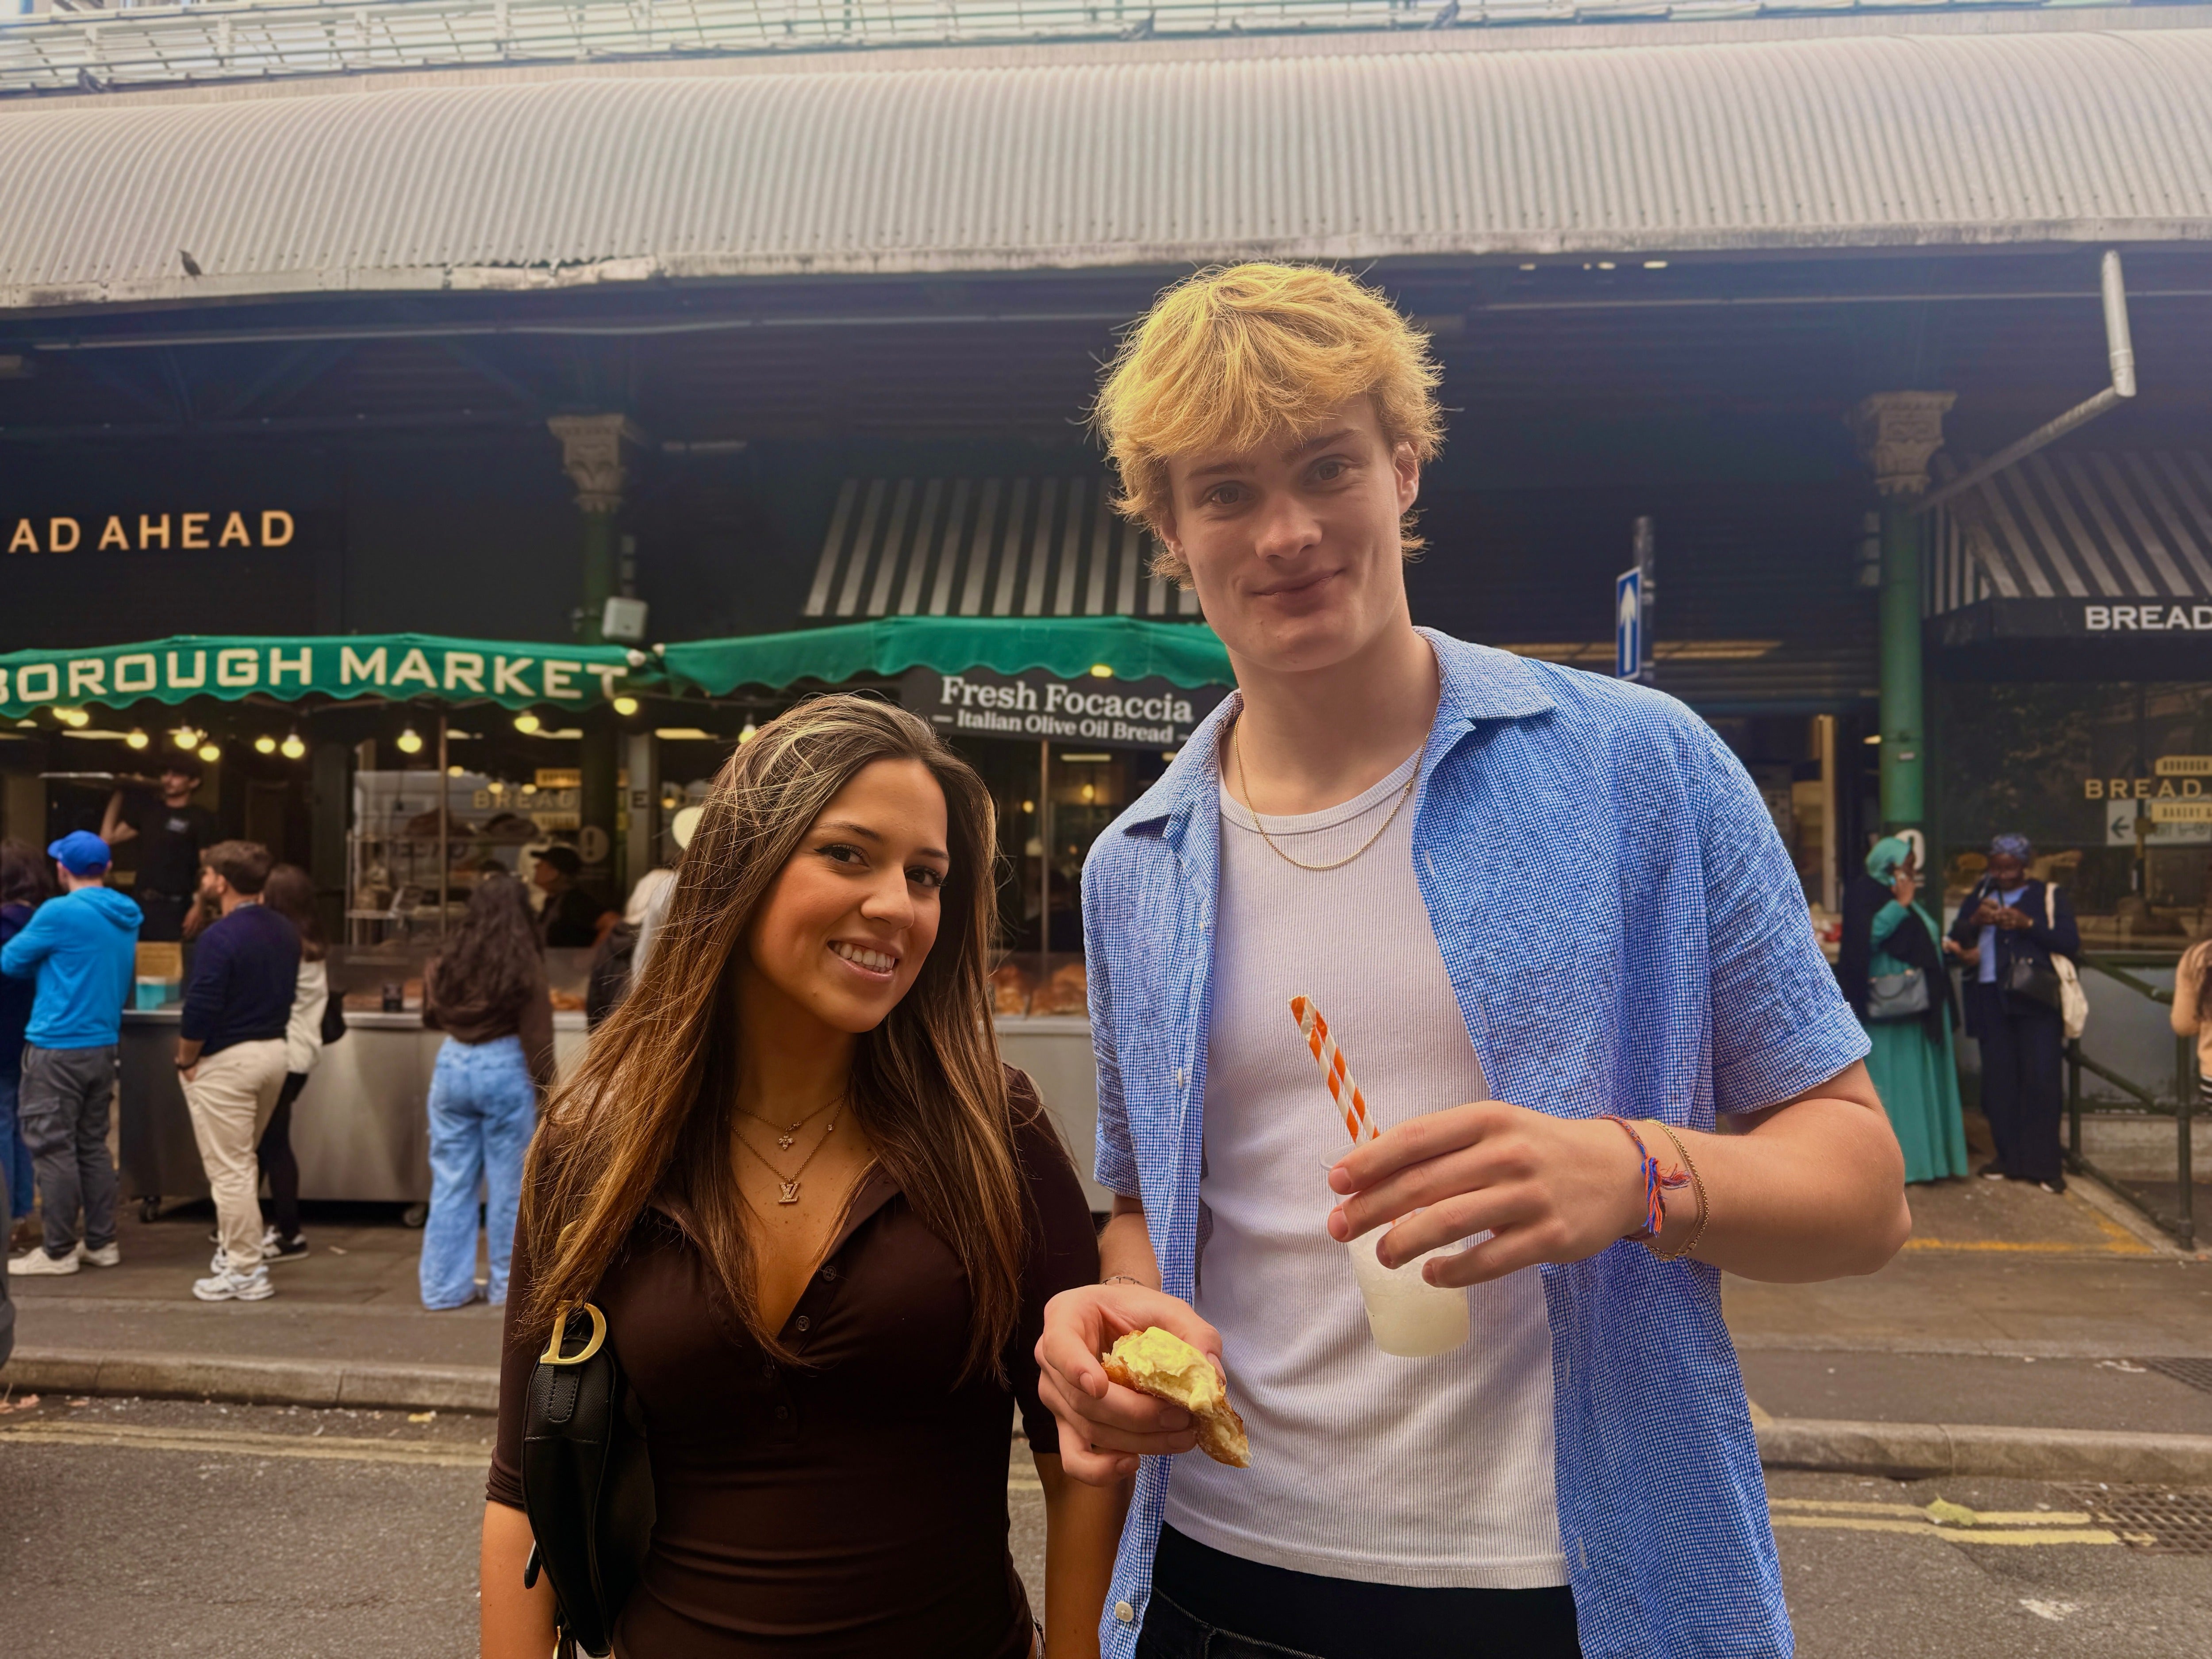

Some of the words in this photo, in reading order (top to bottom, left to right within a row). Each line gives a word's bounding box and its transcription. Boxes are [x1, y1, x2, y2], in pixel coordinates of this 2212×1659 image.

[97, 510, 294, 550] AHEAD
[2085, 605, 2212, 630] BREAD
[0, 647, 312, 704] OROUGH
[341, 646, 628, 701] MARKET
[941, 676, 1037, 710] Fresh
[1045, 684, 1194, 722] Focaccia
[957, 709, 1022, 731] Italian
[1025, 714, 1077, 736] Olive
[1079, 719, 1109, 739] Oil
[1112, 720, 1174, 743] Bread
[2085, 778, 2202, 799] BREAD
